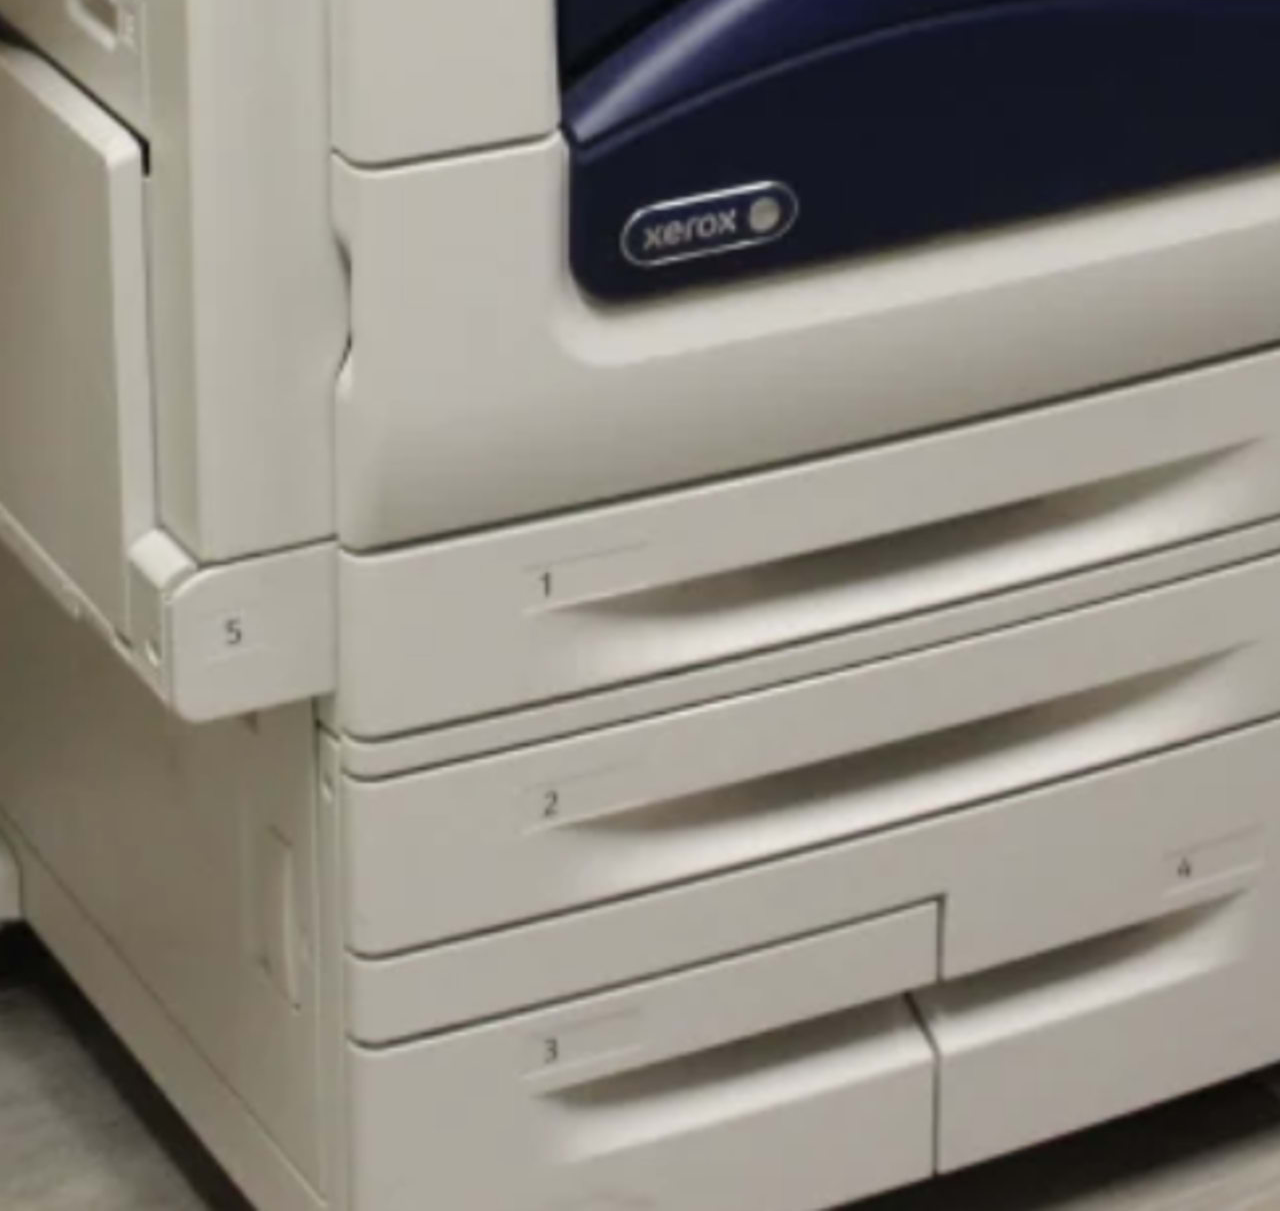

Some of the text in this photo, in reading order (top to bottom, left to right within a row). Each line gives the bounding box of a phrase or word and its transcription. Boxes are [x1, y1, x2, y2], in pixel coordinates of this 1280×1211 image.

[642, 208, 737, 251] xerox
[539, 571, 551, 598] 1
[225, 618, 242, 646] 5
[543, 790, 559, 819] 2
[543, 1038, 558, 1065] 3
